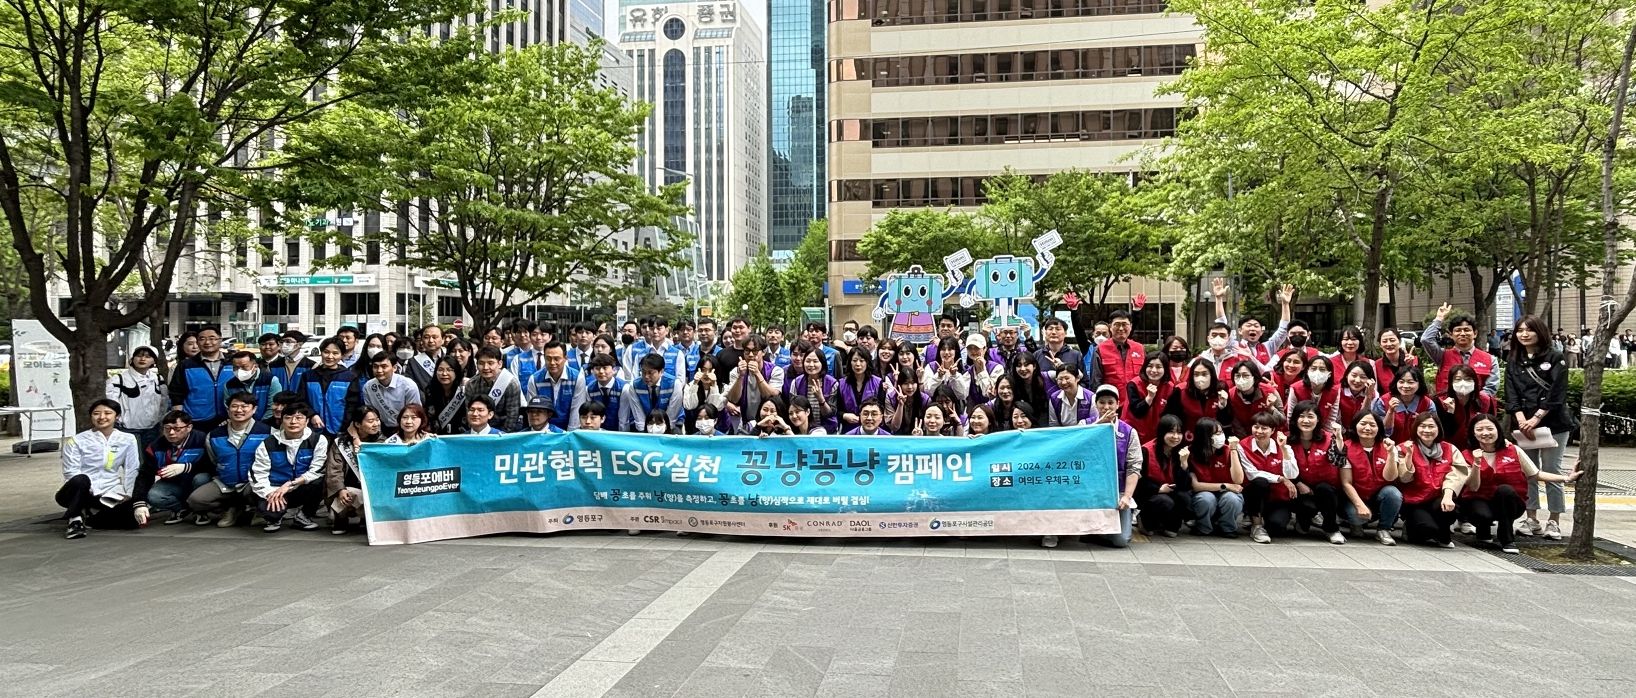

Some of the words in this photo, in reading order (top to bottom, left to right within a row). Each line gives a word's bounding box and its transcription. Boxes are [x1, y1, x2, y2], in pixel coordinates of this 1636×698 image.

[697, 3, 736, 23] 증권
[494, 450, 603, 484] 민관협력
[611, 451, 722, 483] ESG실천
[736, 448, 880, 487] 꽁냥꽁냥
[887, 453, 973, 485] 캠페인
[403, 470, 454, 486] 영등포에버
[992, 476, 1012, 486] 장소
[1018, 475, 1043, 485] 여의도
[1045, 475, 1070, 485] 우체국
[1072, 475, 1081, 485] 앞
[397, 483, 460, 495] YeongdeungpoEver
[593, 491, 608, 500] 담배
[576, 514, 603, 523] 영등포구
[643, 515, 660, 524] CSR
